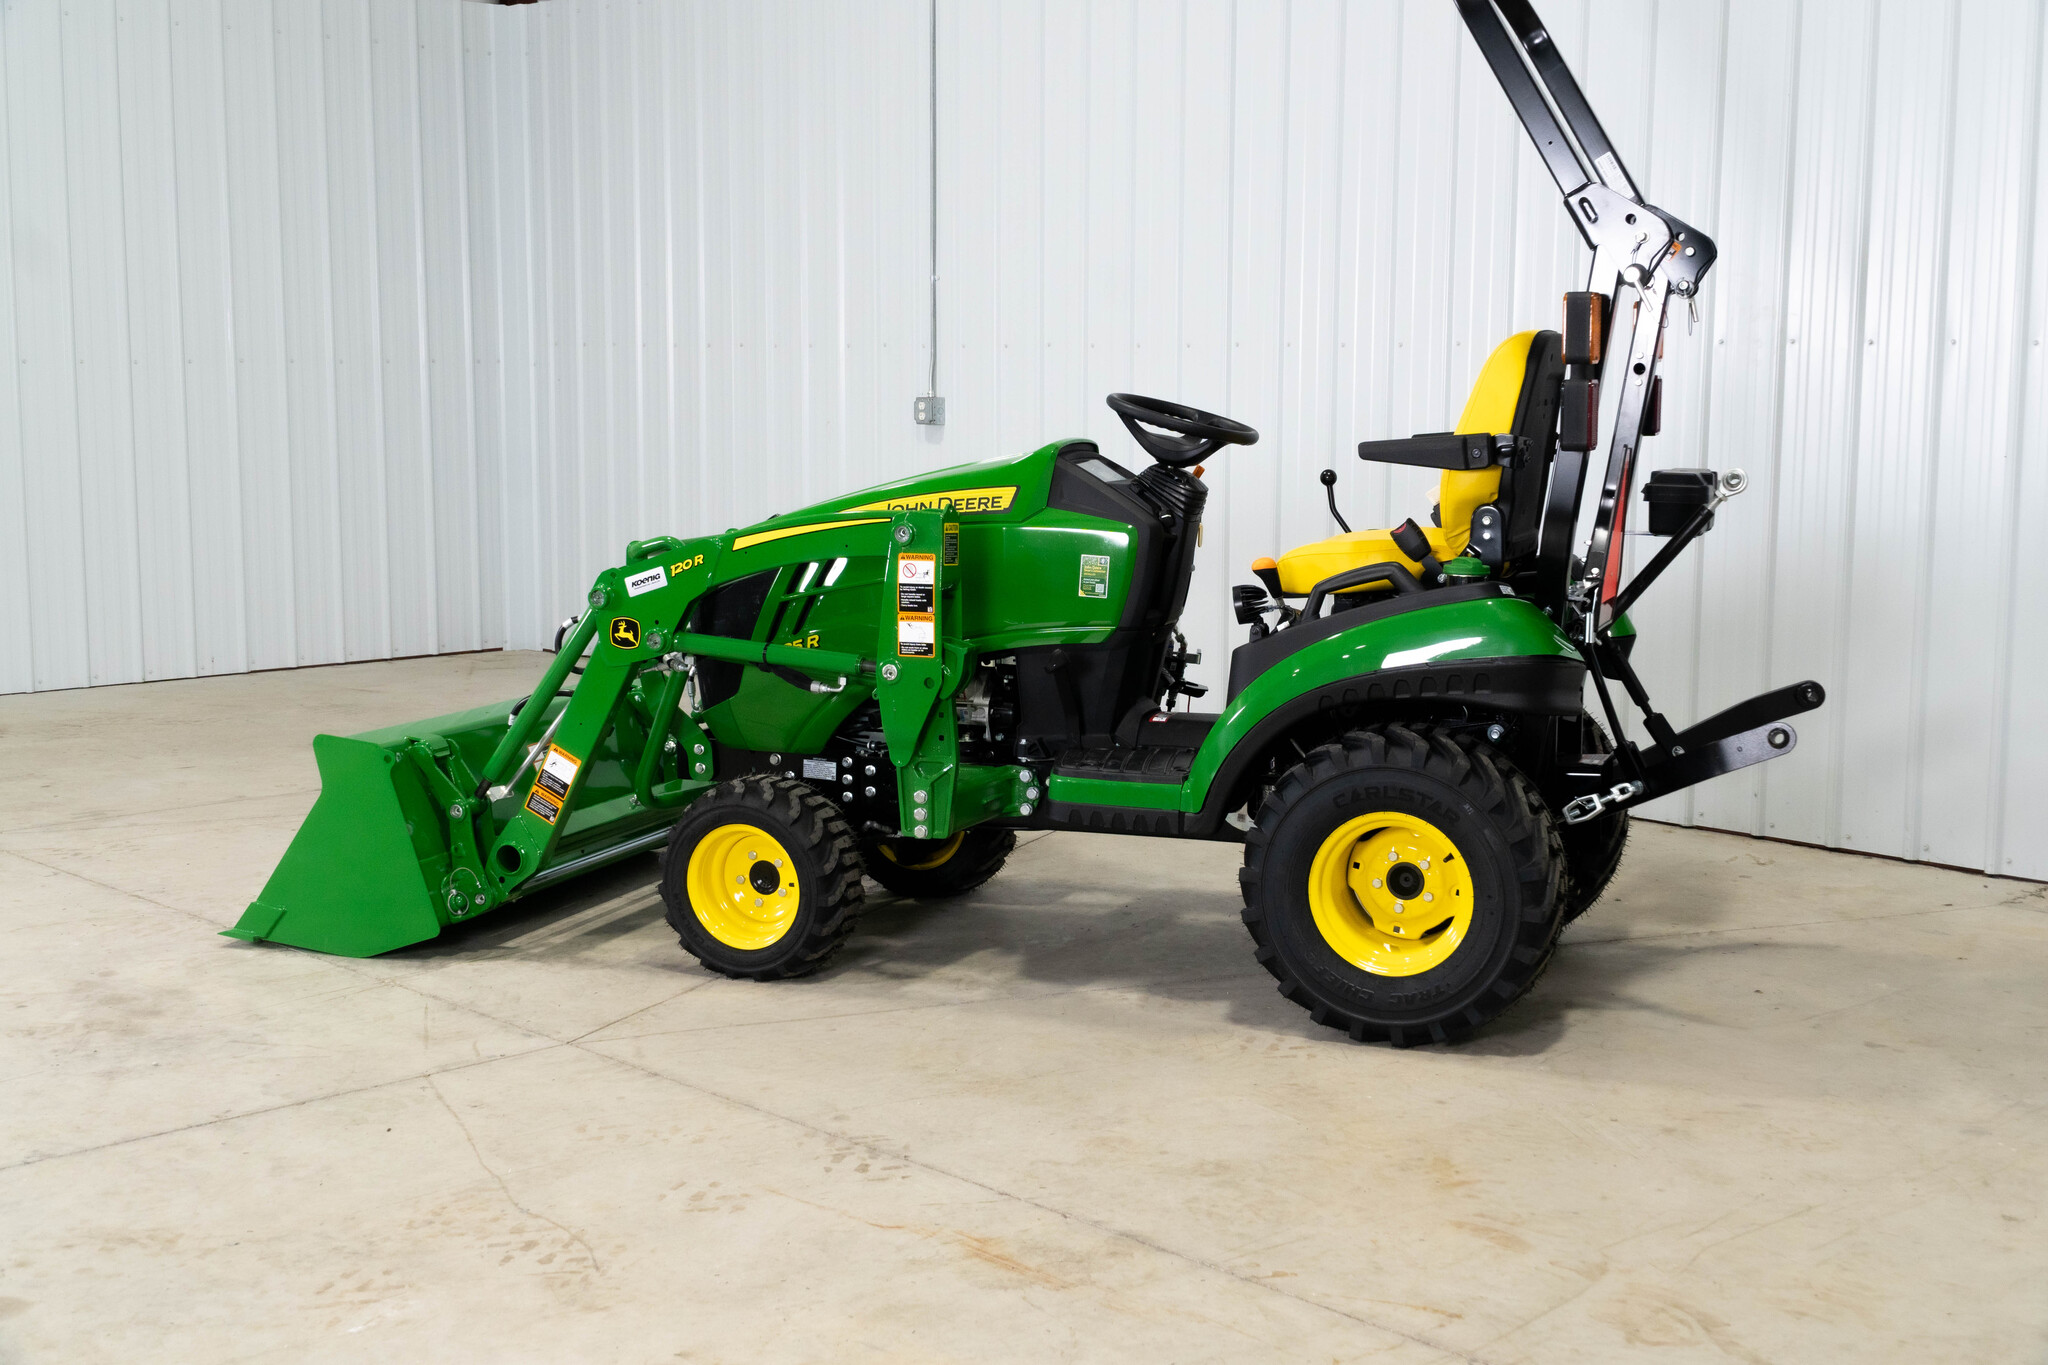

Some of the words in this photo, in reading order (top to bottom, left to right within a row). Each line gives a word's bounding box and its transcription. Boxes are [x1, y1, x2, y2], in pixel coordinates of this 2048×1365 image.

[938, 497, 1003, 511] DEERE
[670, 562, 693, 577] 120
[694, 554, 704, 567] R
[807, 635, 819, 649] R
[558, 749, 578, 764] WARNING
[540, 791, 559, 806] WARNING
[1332, 785, 1460, 824] CARLSTAR
